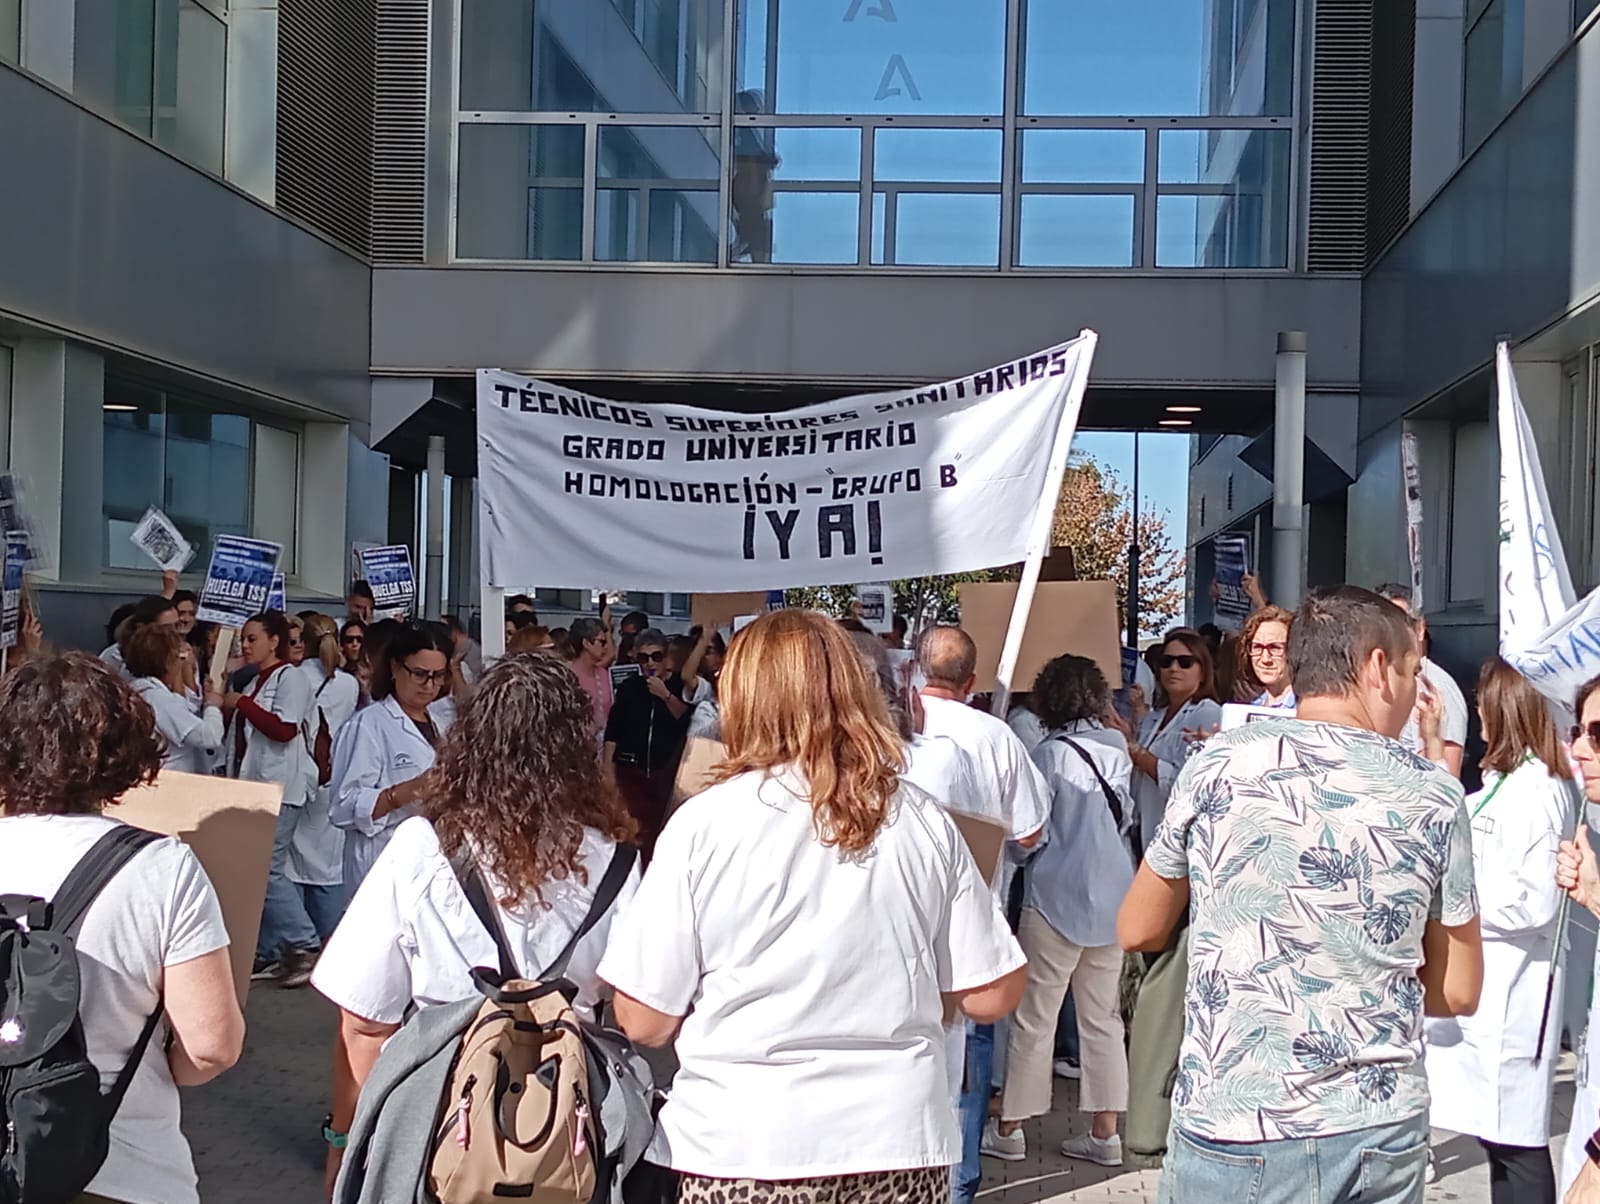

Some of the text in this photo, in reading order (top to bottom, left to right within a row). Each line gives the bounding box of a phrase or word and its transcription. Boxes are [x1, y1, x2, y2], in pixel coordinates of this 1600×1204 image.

[494, 349, 1068, 433] TÉCNICOS SUPERIORES SANITARIOS
[563, 420, 917, 462] GRADO UNIVERSITARIO
[564, 472, 797, 504] HOMOLOGACIÓN
[206, 577, 247, 598] HUELGA
[247, 584, 267, 602] TSS
